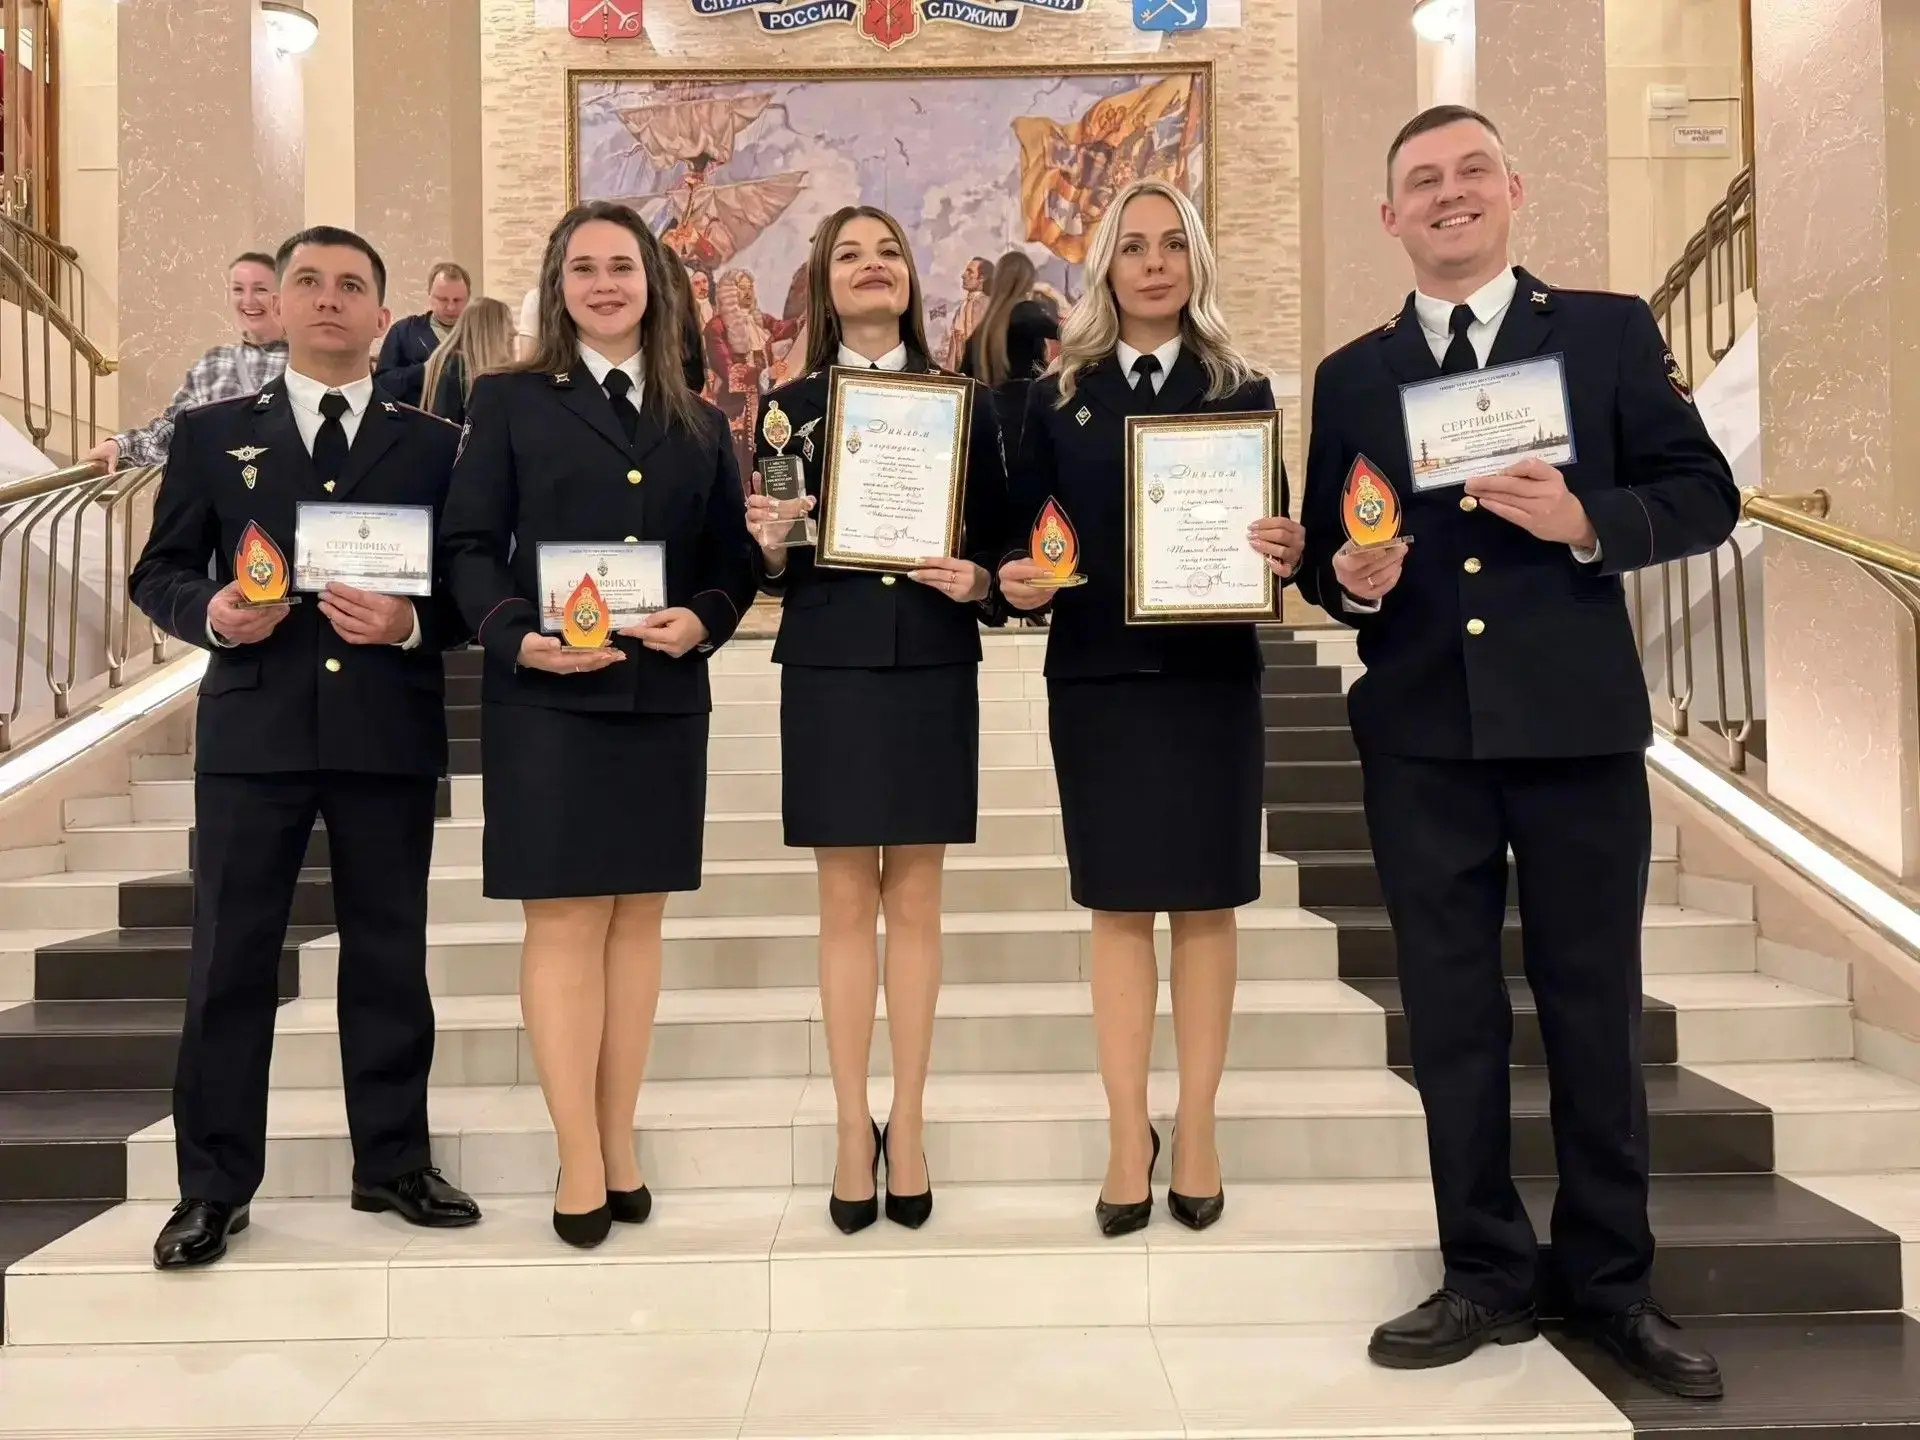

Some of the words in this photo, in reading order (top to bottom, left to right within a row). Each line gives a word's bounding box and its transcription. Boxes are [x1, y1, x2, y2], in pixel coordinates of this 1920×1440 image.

[769, 3, 849, 29] РОССИИ
[927, 2, 1008, 27] СЛУЖИМ
[1441, 407, 1531, 433] СЕРТИФИКАТ
[326, 540, 403, 552] СЕРТИФИКАТ
